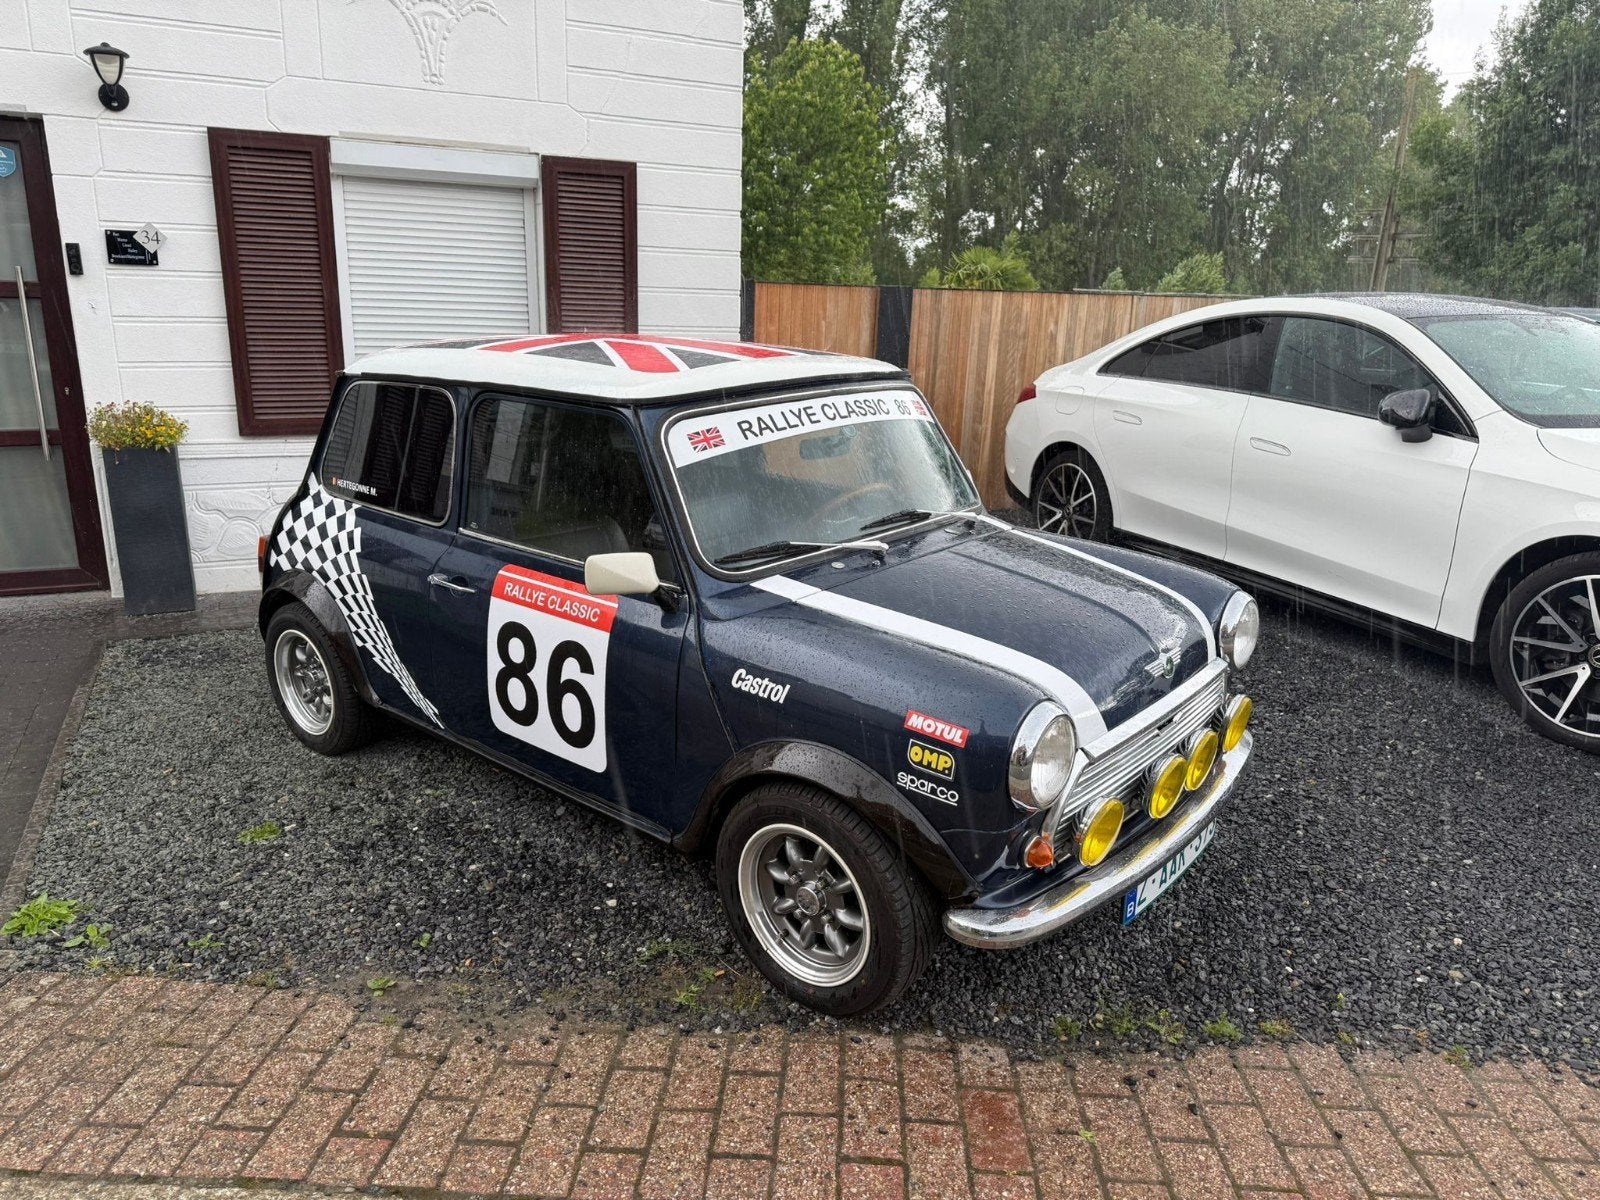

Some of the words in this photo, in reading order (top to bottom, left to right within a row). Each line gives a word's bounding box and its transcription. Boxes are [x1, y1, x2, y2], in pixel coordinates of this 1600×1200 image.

[140, 230, 161, 245] 34
[736, 405, 821, 441] RALLYE
[820, 399, 890, 422] CLASSIC
[896, 398, 912, 416] 86
[503, 582, 545, 606] RALLYE
[547, 595, 601, 622] CLASSIC
[495, 620, 596, 749] 86
[731, 668, 791, 704] Castrol
[907, 713, 963, 744] MOTUL
[910, 745, 952, 771] OMP
[897, 771, 960, 803] sparco
[1126, 901, 1135, 919] B
